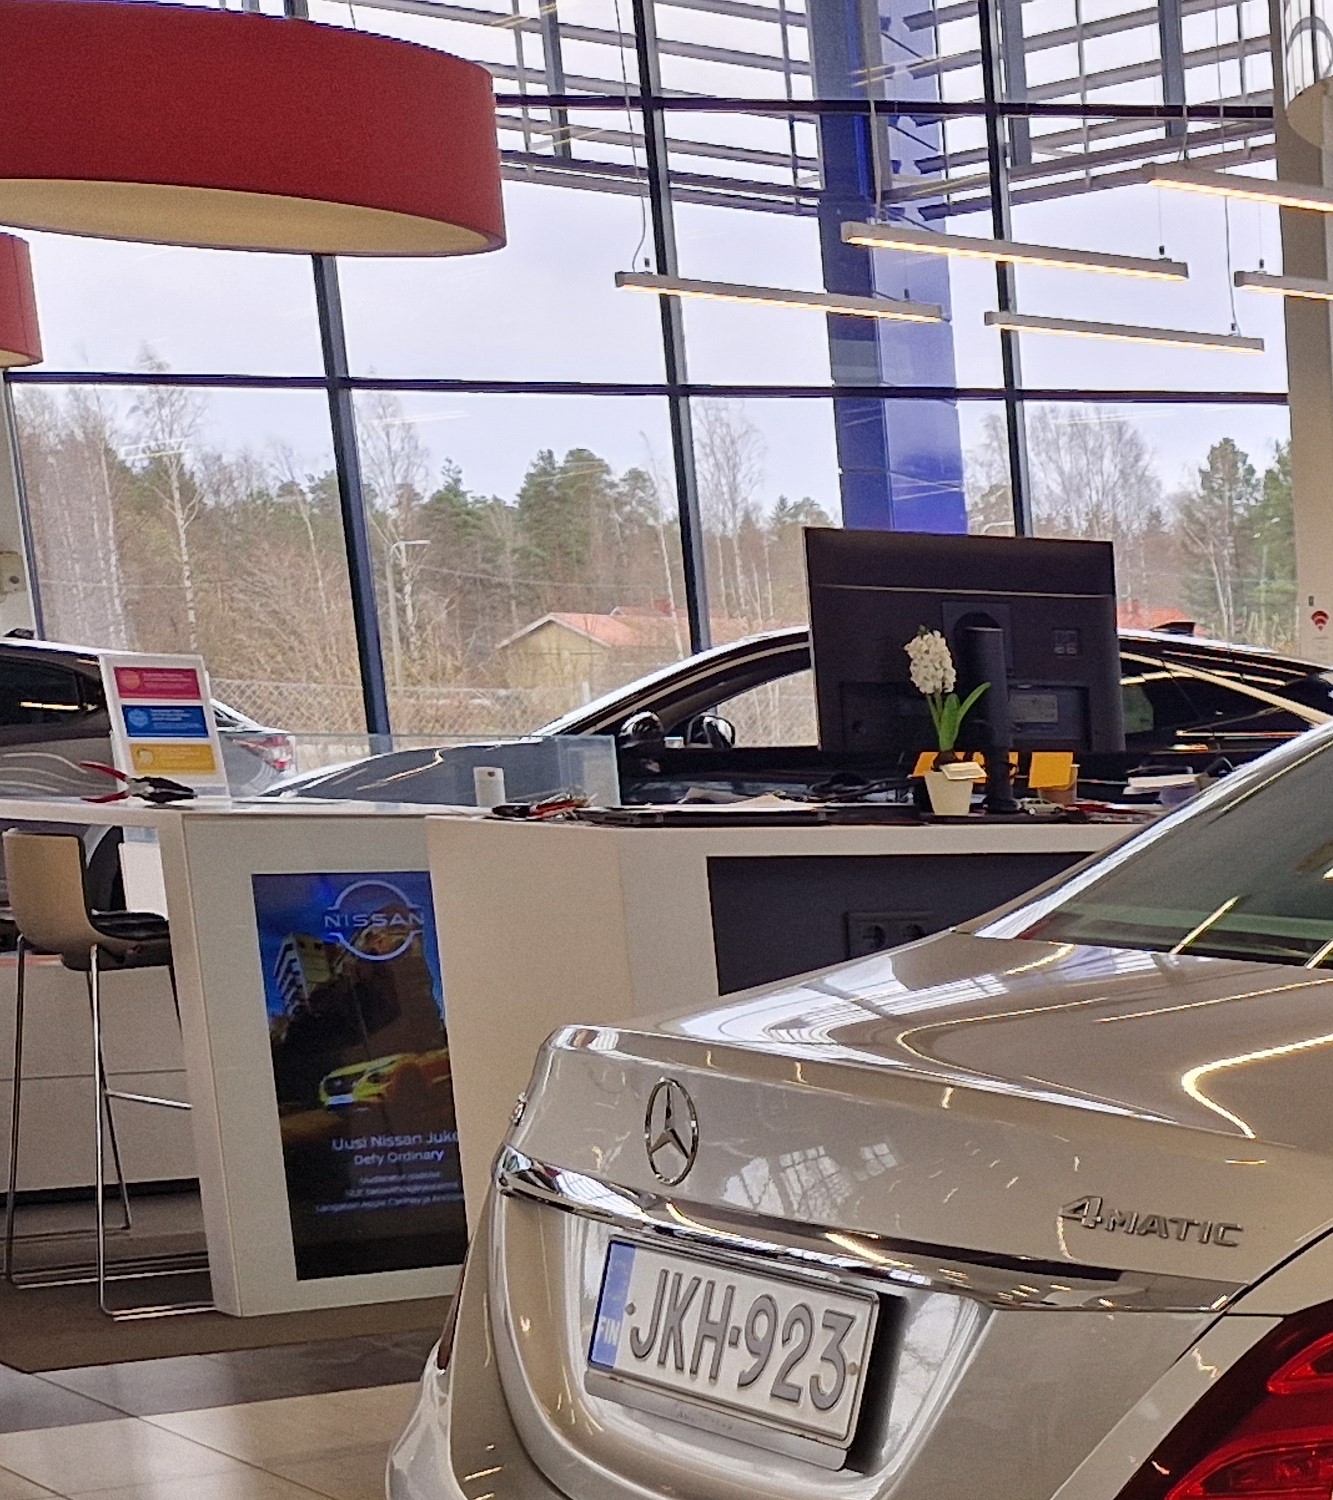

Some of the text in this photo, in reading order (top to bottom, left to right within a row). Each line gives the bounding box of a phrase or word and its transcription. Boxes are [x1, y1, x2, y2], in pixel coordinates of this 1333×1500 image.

[324, 912, 424, 928] NISSAN
[332, 1135, 367, 1151] Uusi
[371, 1133, 422, 1149] Nissan
[354, 1150, 445, 1167] Defy Ordinary
[1057, 1195, 1245, 1248] 4MATIC
[598, 1315, 622, 1347] FIN
[629, 1268, 857, 1412] JKH-923
